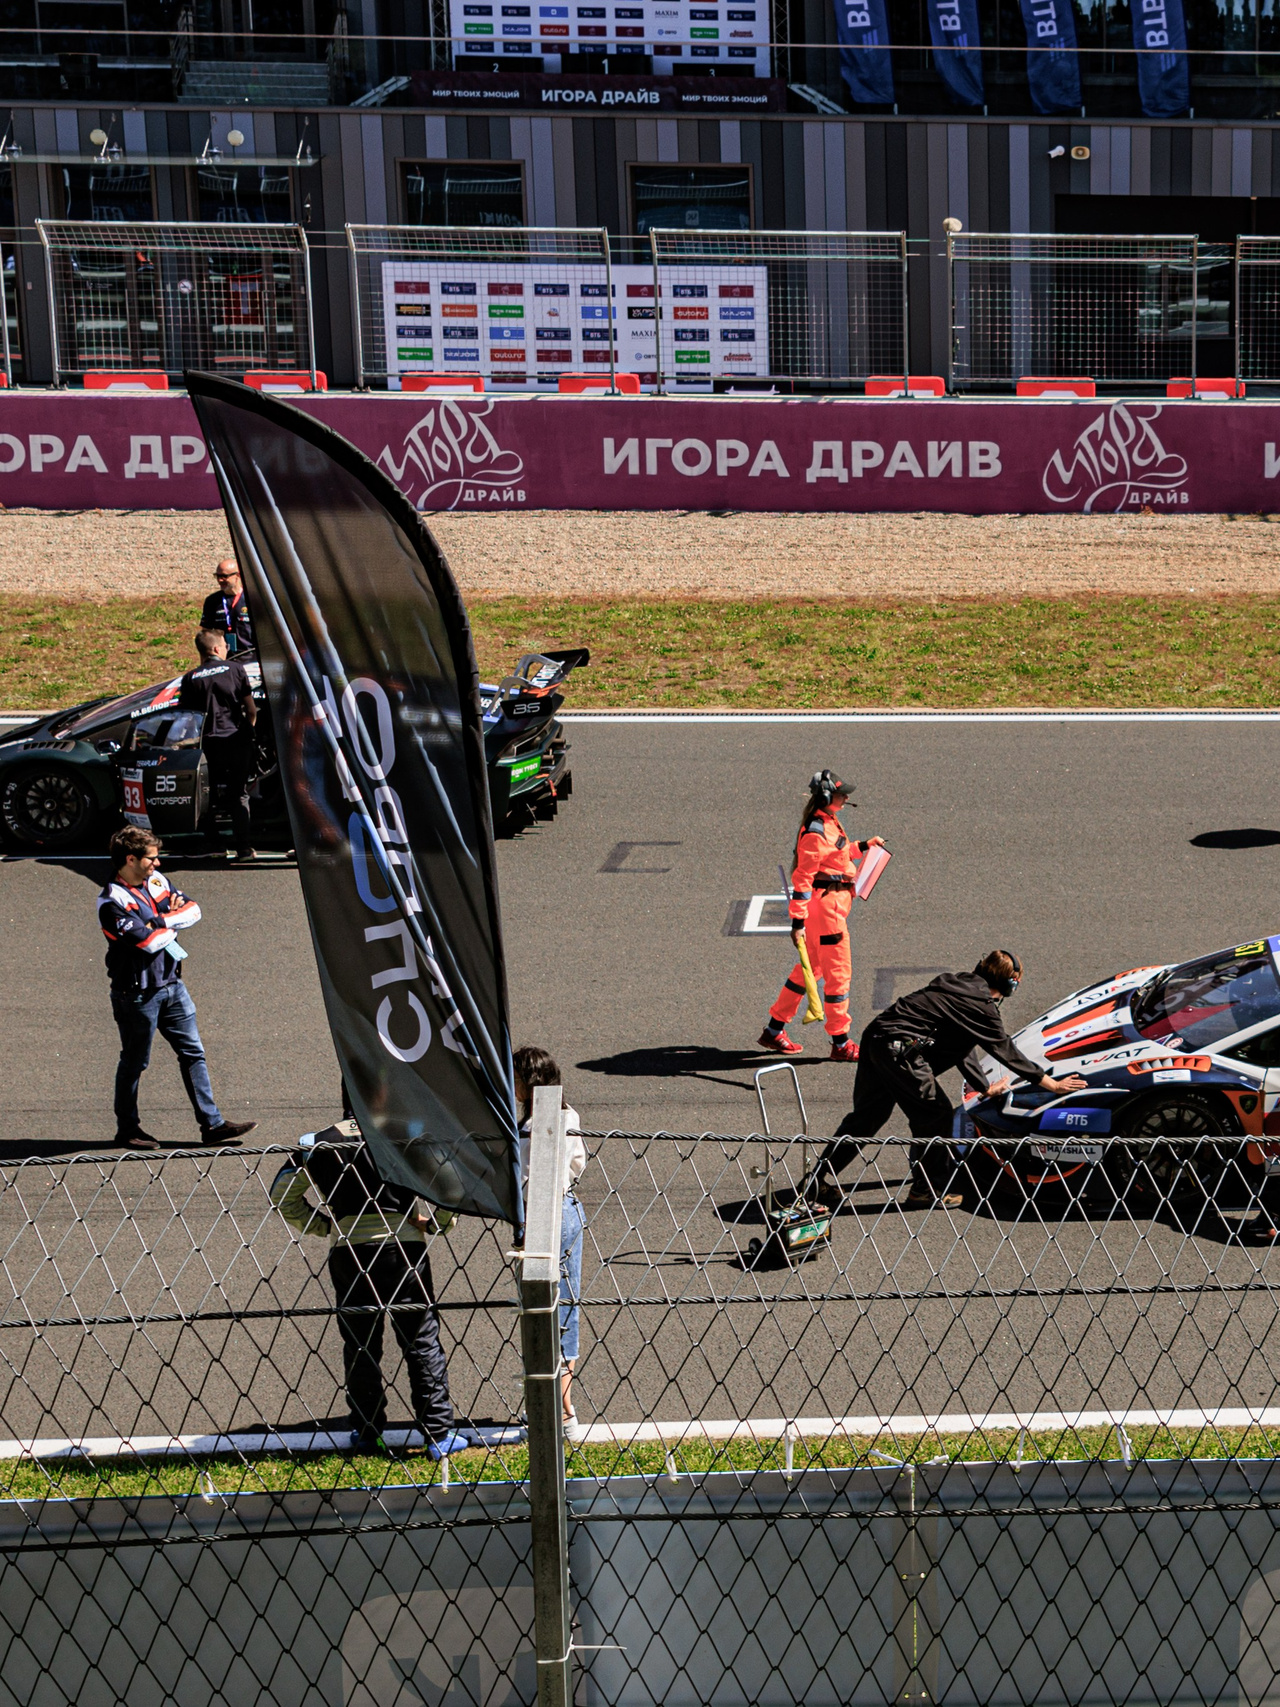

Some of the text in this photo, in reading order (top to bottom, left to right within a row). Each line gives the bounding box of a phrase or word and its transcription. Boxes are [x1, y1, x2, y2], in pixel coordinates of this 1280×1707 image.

[937, 0, 961, 31] ВТ
[1030, 0, 1058, 37] ВТ
[493, 63, 499, 73] 2
[602, 58, 609, 74] 1
[483, 90, 520, 99] ЭМОЦИЙ
[542, 88, 660, 105] ИГОРА ДРАЙВ
[731, 95, 768, 104] ЭМОЦИЙ
[0, 434, 107, 473] ОРА
[603, 437, 1002, 484] ИГОРА ДРАЙВ
[462, 488, 527, 502] ДРАЙВ
[1128, 489, 1189, 504] ДРАЙВ
[124, 786, 141, 808] 93
[146, 797, 191, 805] MOTORSPORT
[1066, 1114, 1088, 1126] ВТБ
[1047, 1145, 1096, 1155] MARSHALL
